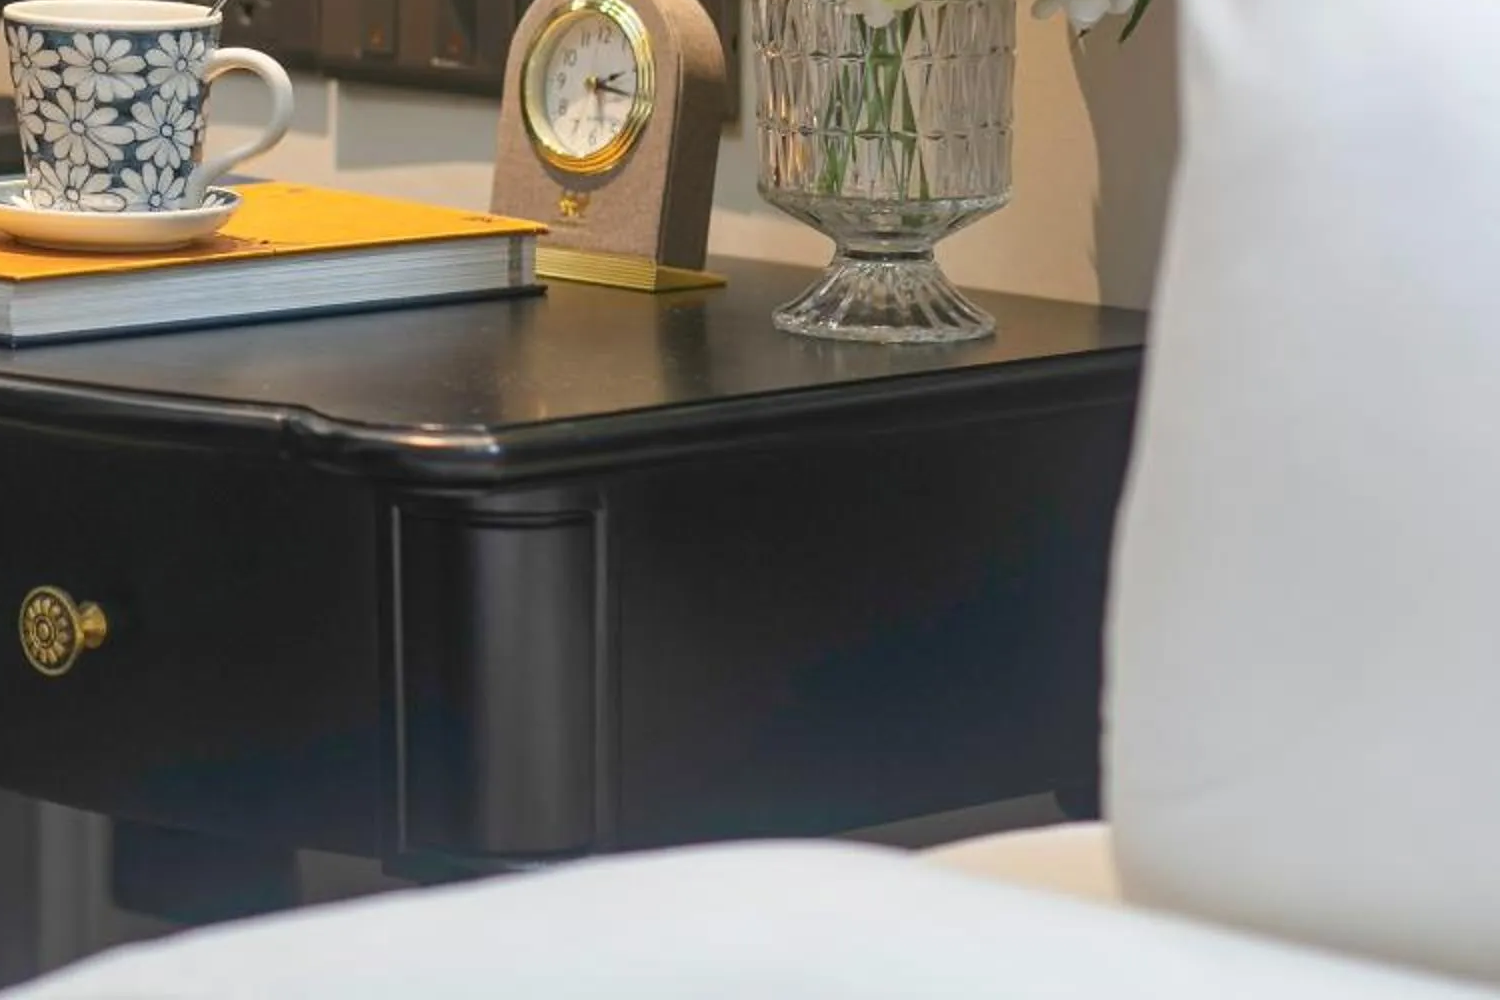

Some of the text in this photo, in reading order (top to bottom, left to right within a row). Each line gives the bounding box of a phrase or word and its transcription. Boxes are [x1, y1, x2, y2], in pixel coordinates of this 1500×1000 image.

[581, 31, 590, 47] 11
[598, 25, 612, 44] 12
[563, 48, 577, 66] 10
[557, 72, 566, 88] 9
[558, 99, 568, 115] 8
[573, 119, 580, 133] 7
[589, 129, 597, 146] 6
